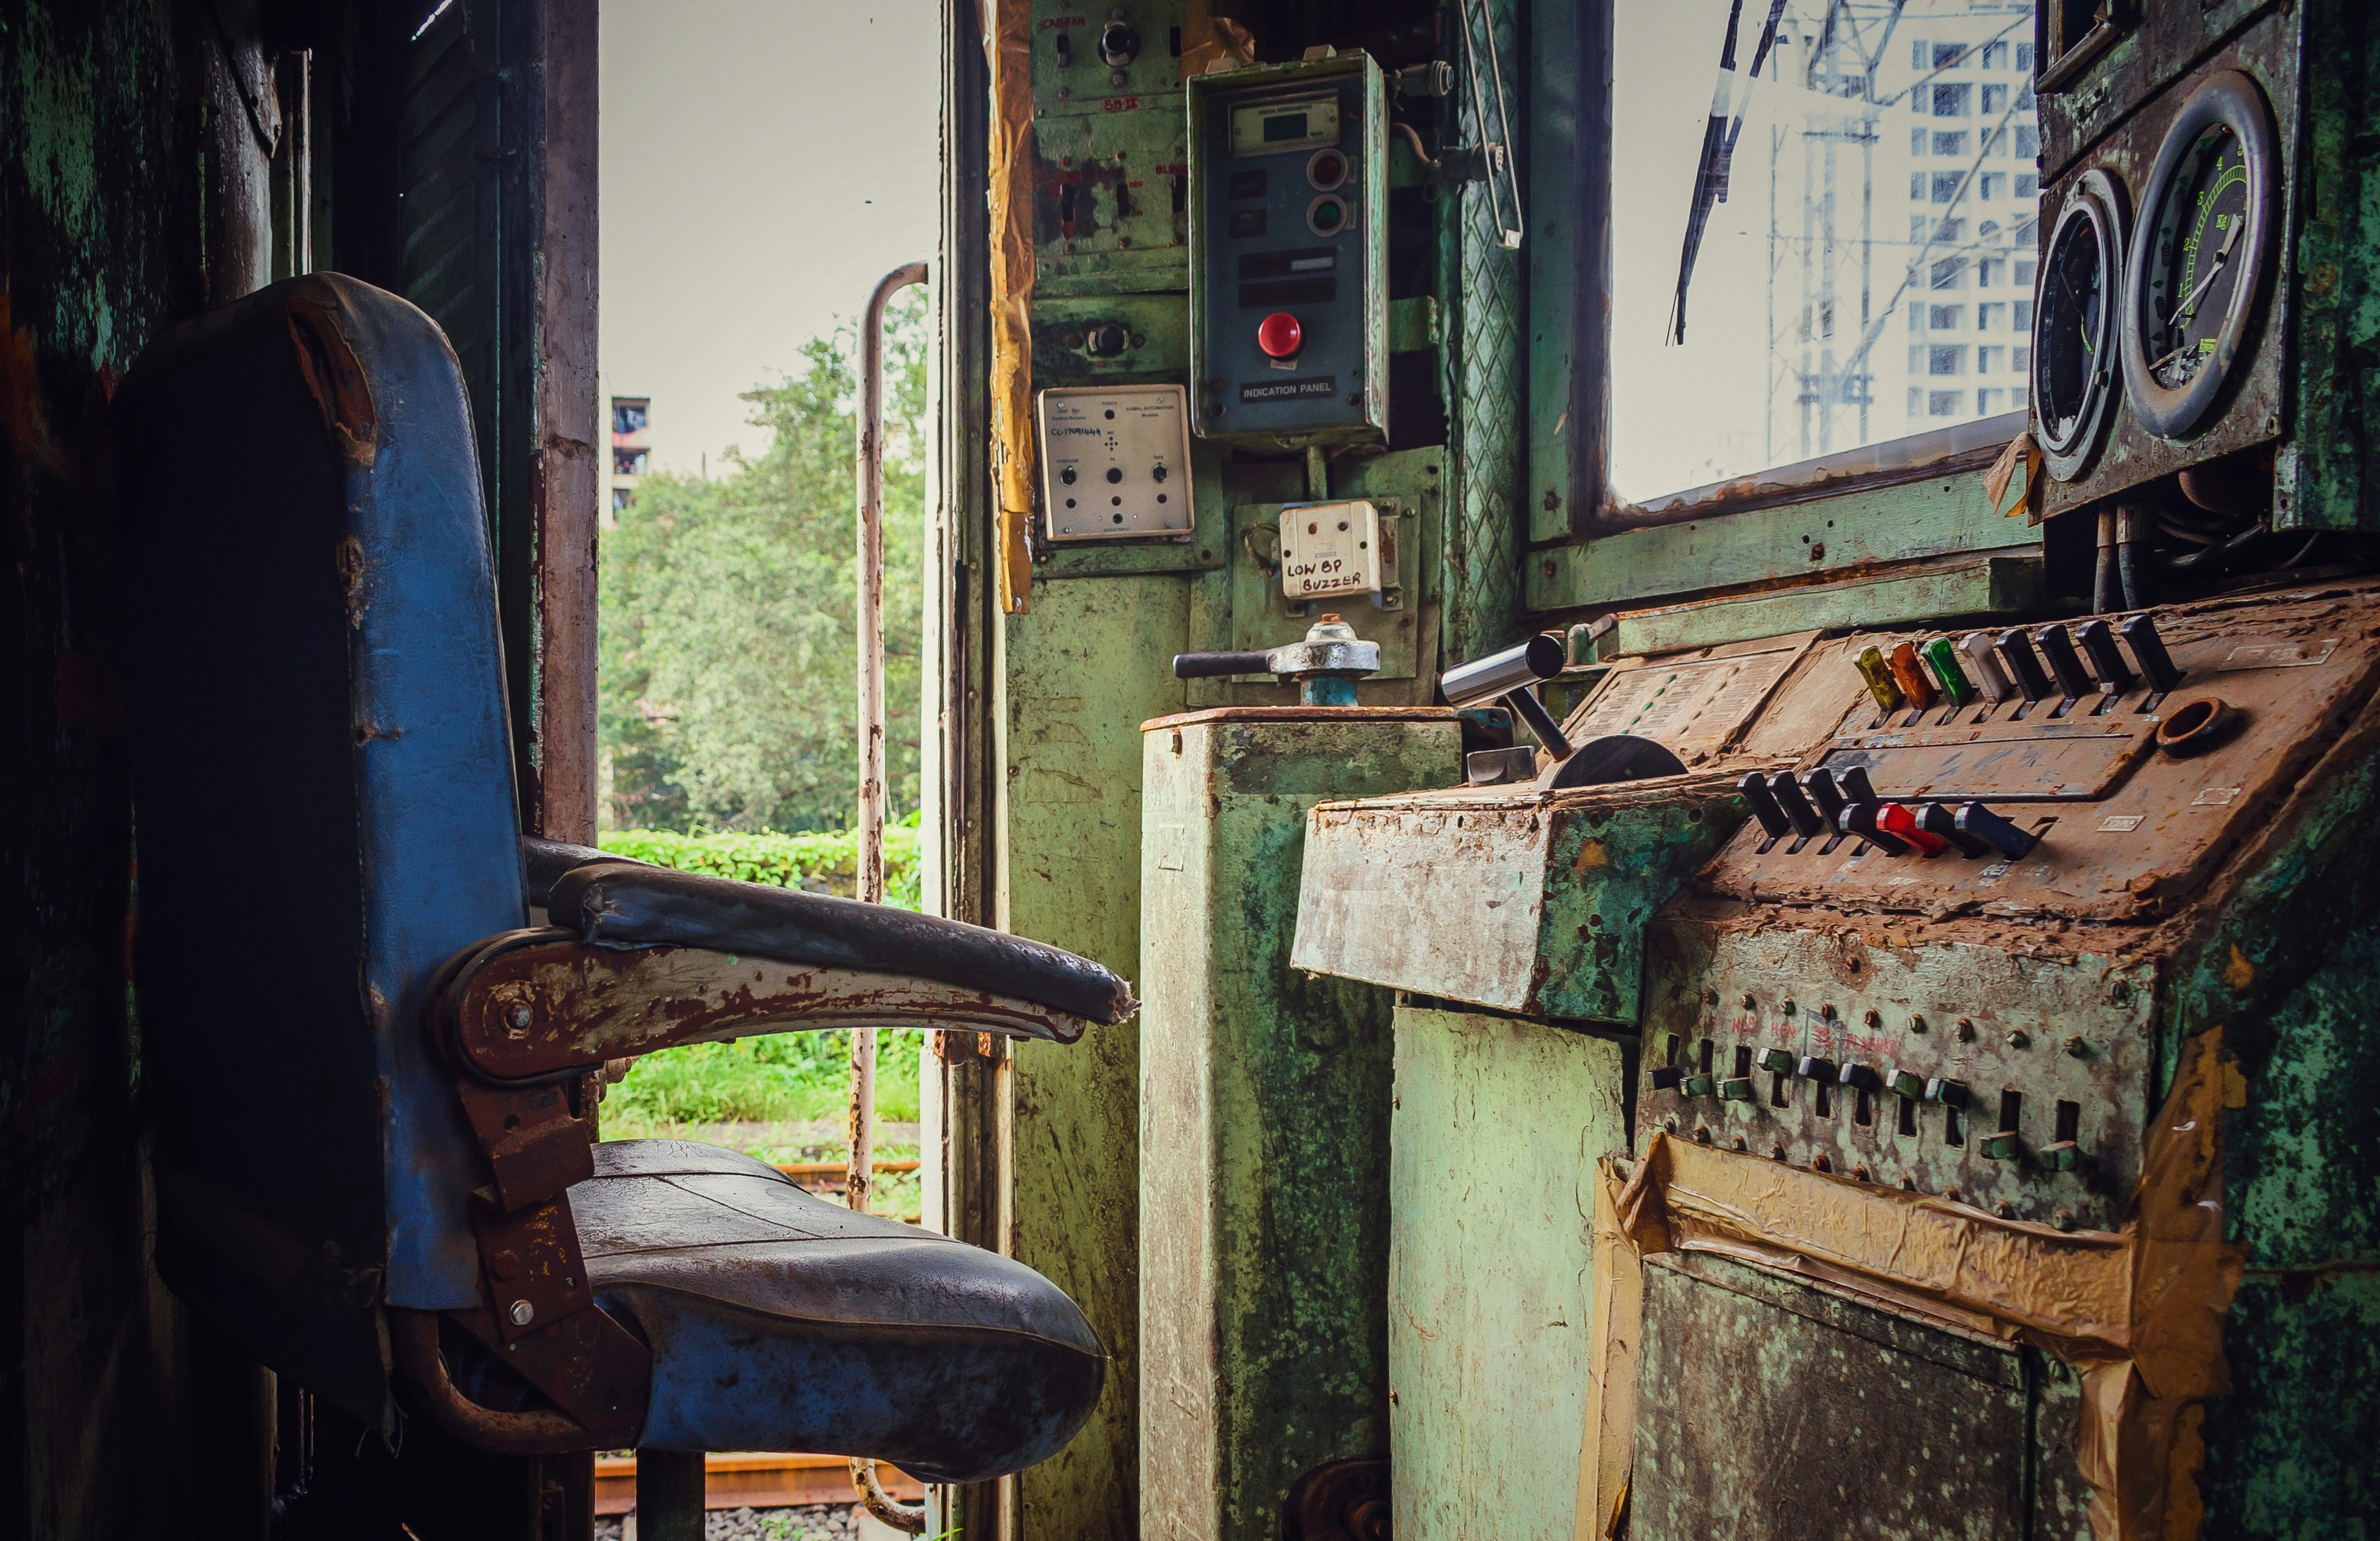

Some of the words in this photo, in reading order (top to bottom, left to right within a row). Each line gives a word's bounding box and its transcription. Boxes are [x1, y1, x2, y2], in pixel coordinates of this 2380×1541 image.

[2216, 156, 2223, 171] 4
[2198, 191, 2205, 205] 3
[2183, 237, 2190, 252] 2
[2177, 283, 2183, 297] 1
[1244, 385, 1296, 398] INDICATION
[1300, 383, 1331, 393] PANEL
[1287, 563, 1316, 577] LOW
[1321, 559, 1342, 573] BP
[1303, 571, 1361, 591] BUZZER
